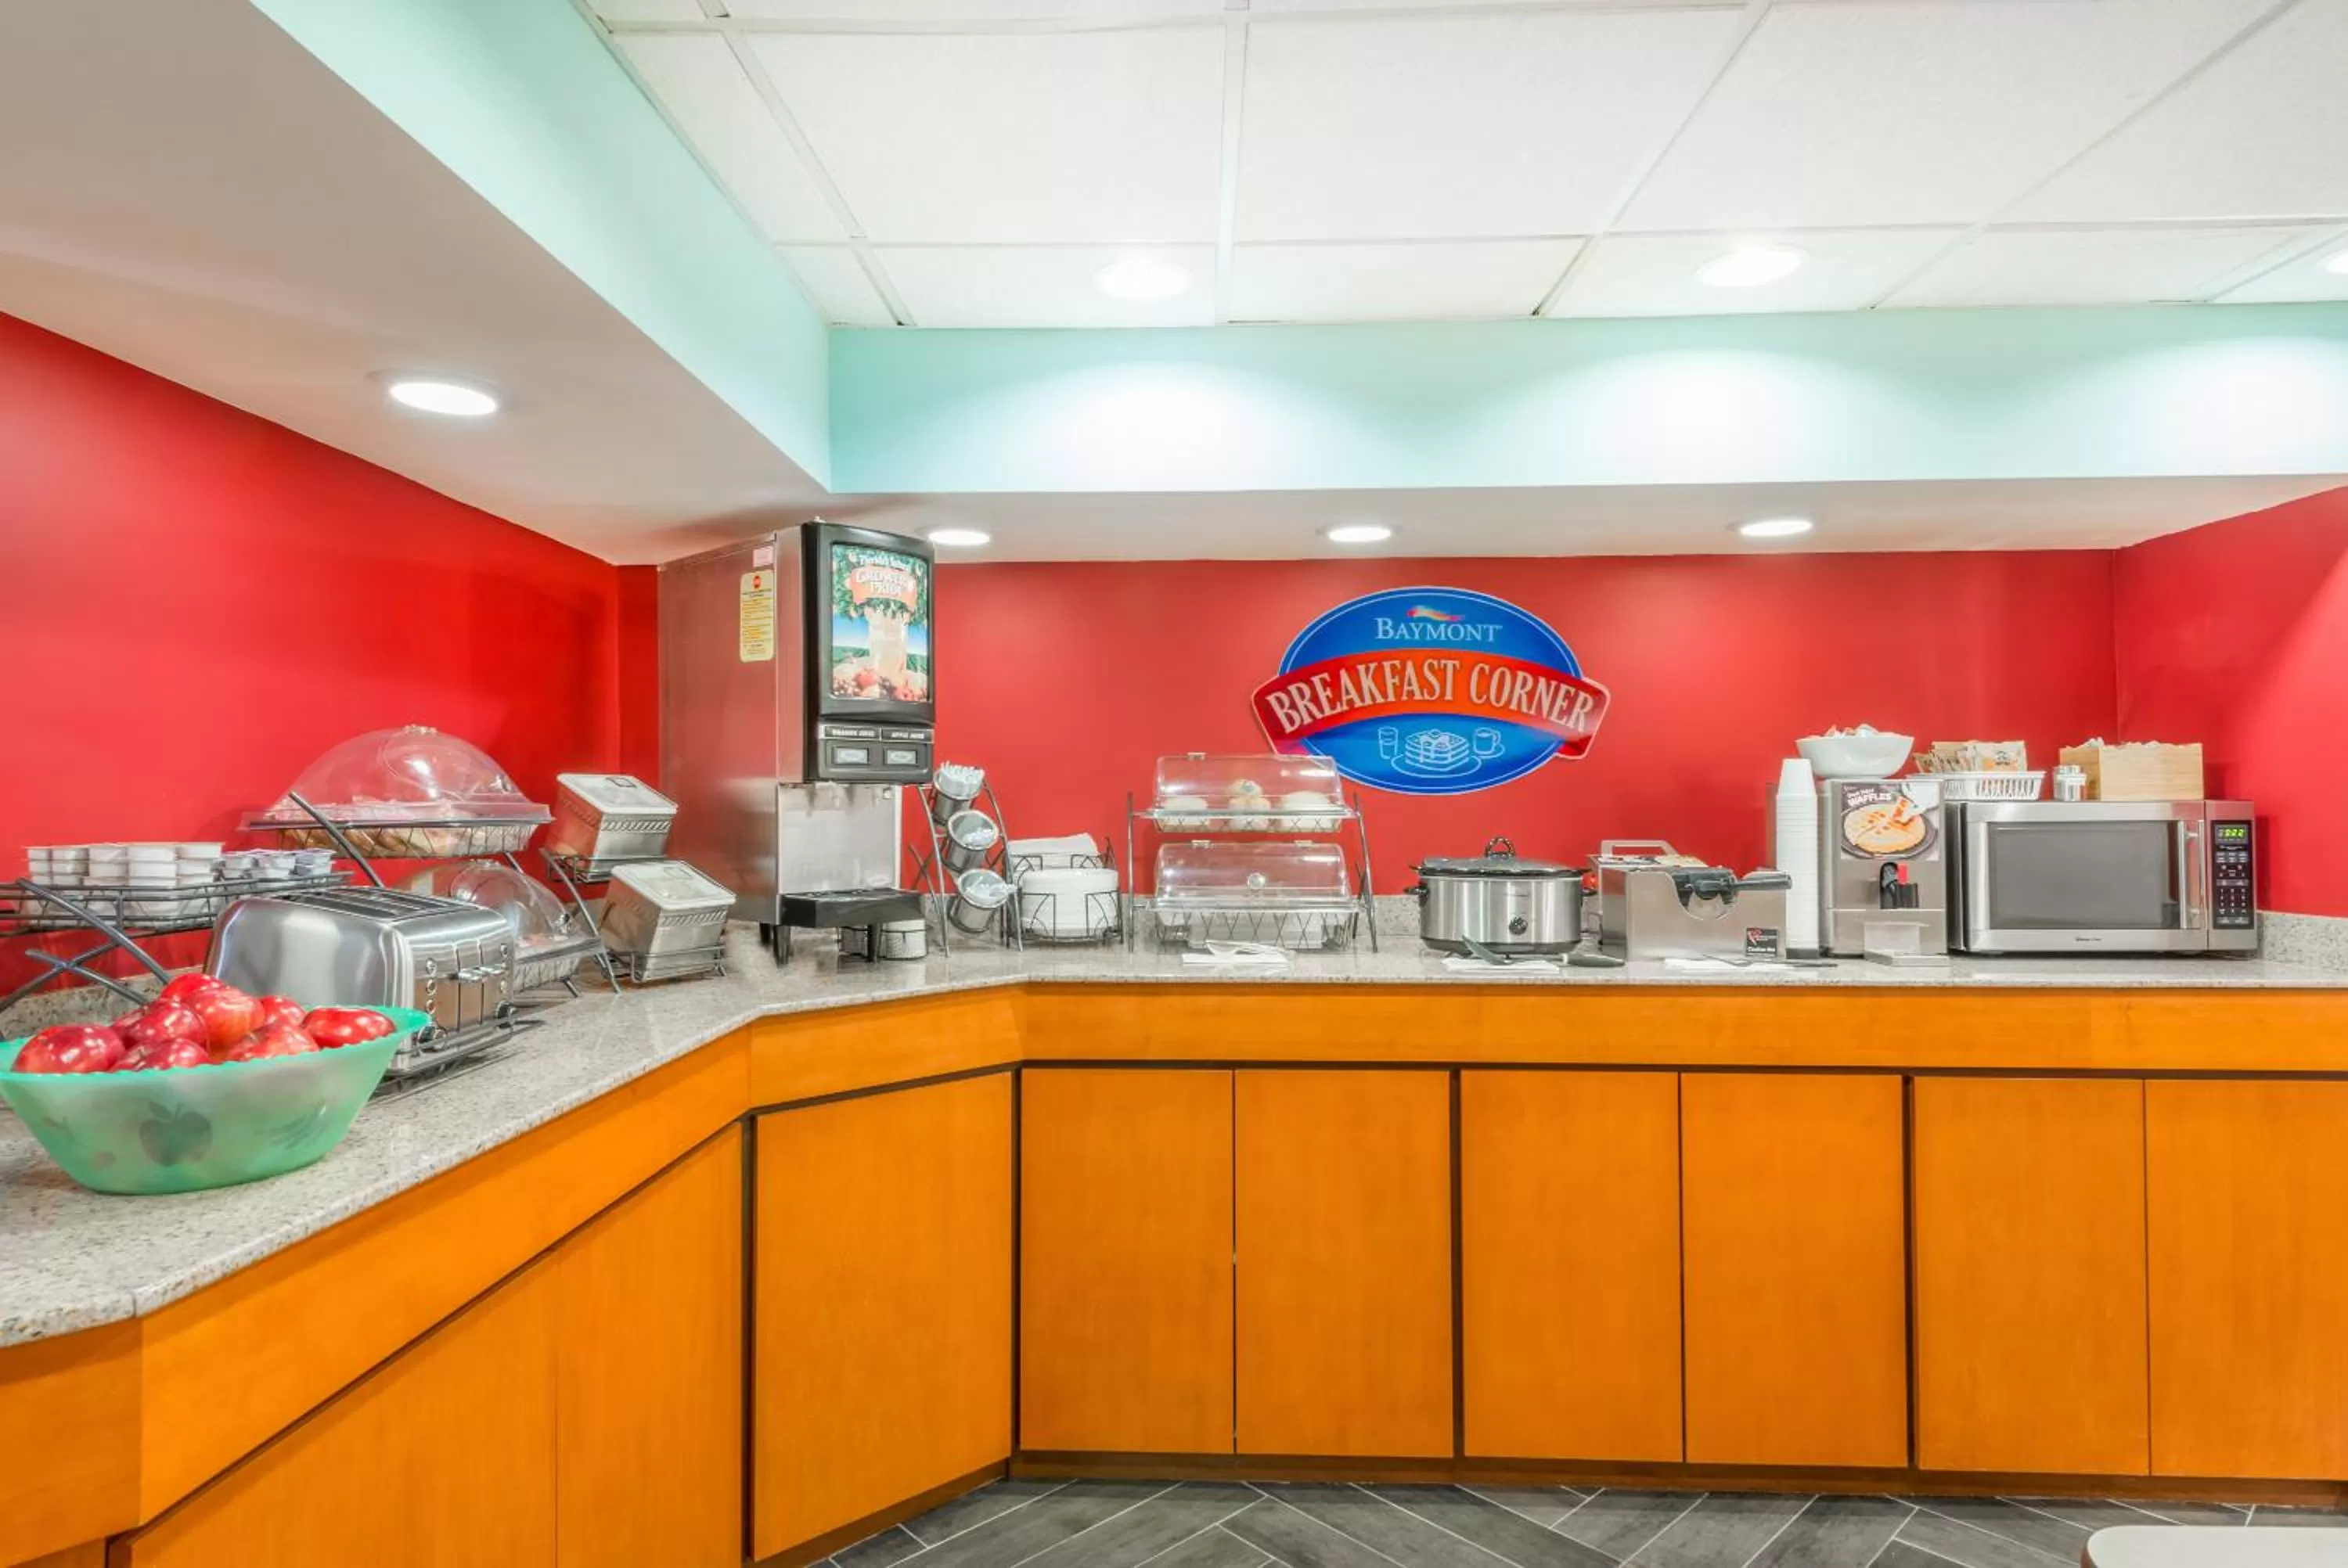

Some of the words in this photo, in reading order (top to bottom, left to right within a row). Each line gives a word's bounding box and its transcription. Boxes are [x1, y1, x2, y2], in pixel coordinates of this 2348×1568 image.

[1374, 617, 1503, 642] BAYMONT
[1267, 658, 1459, 735] BREAKFAST
[1469, 663, 1594, 732] CORNER
